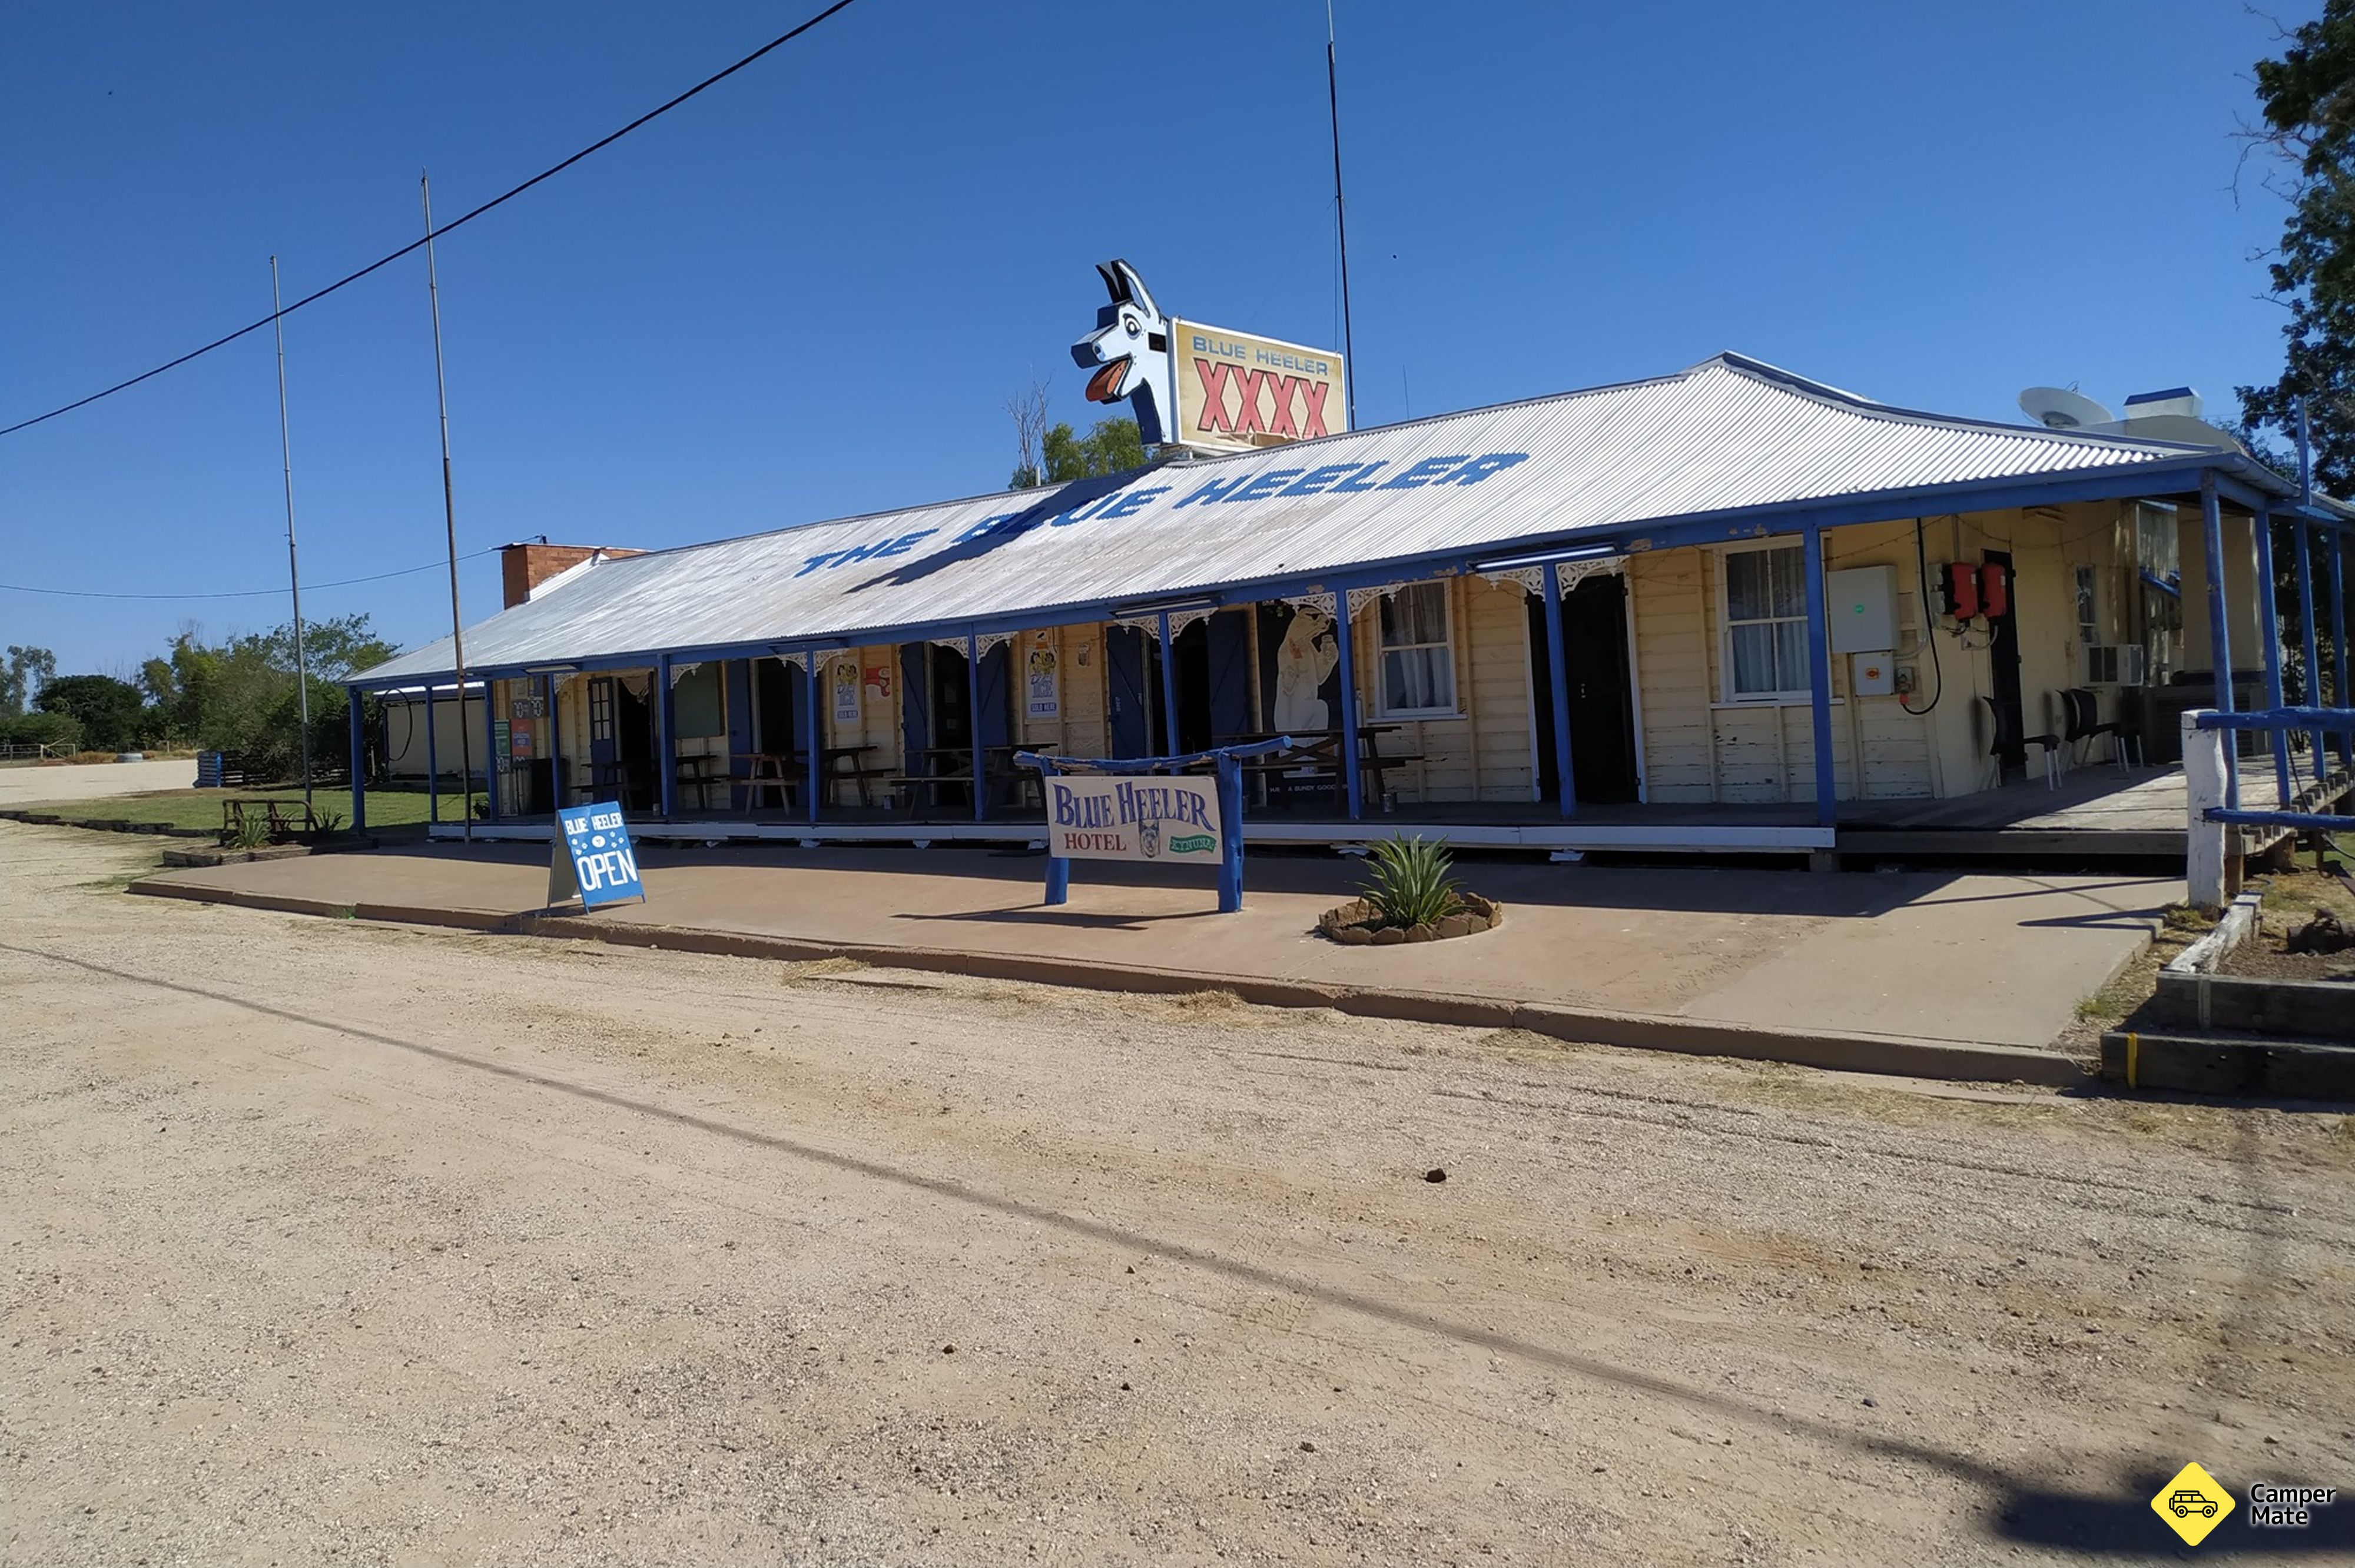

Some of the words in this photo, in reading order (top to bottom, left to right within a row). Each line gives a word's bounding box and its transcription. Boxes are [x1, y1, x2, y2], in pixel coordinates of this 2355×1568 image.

[1193, 336, 1245, 360] BLUE
[1256, 348, 1328, 376] HEELER
[1193, 357, 1329, 439] XXXX
[794, 527, 940, 578] THE
[949, 486, 1172, 544] BLUE
[1170, 453, 1530, 510] HEELER
[564, 817, 589, 835] BLUE
[591, 812, 624, 831] HEELER
[1052, 783, 1115, 828] BLUE
[1115, 781, 1216, 832] HEELER
[1064, 832, 1127, 852] HOTEL
[576, 848, 638, 892] OPEN
